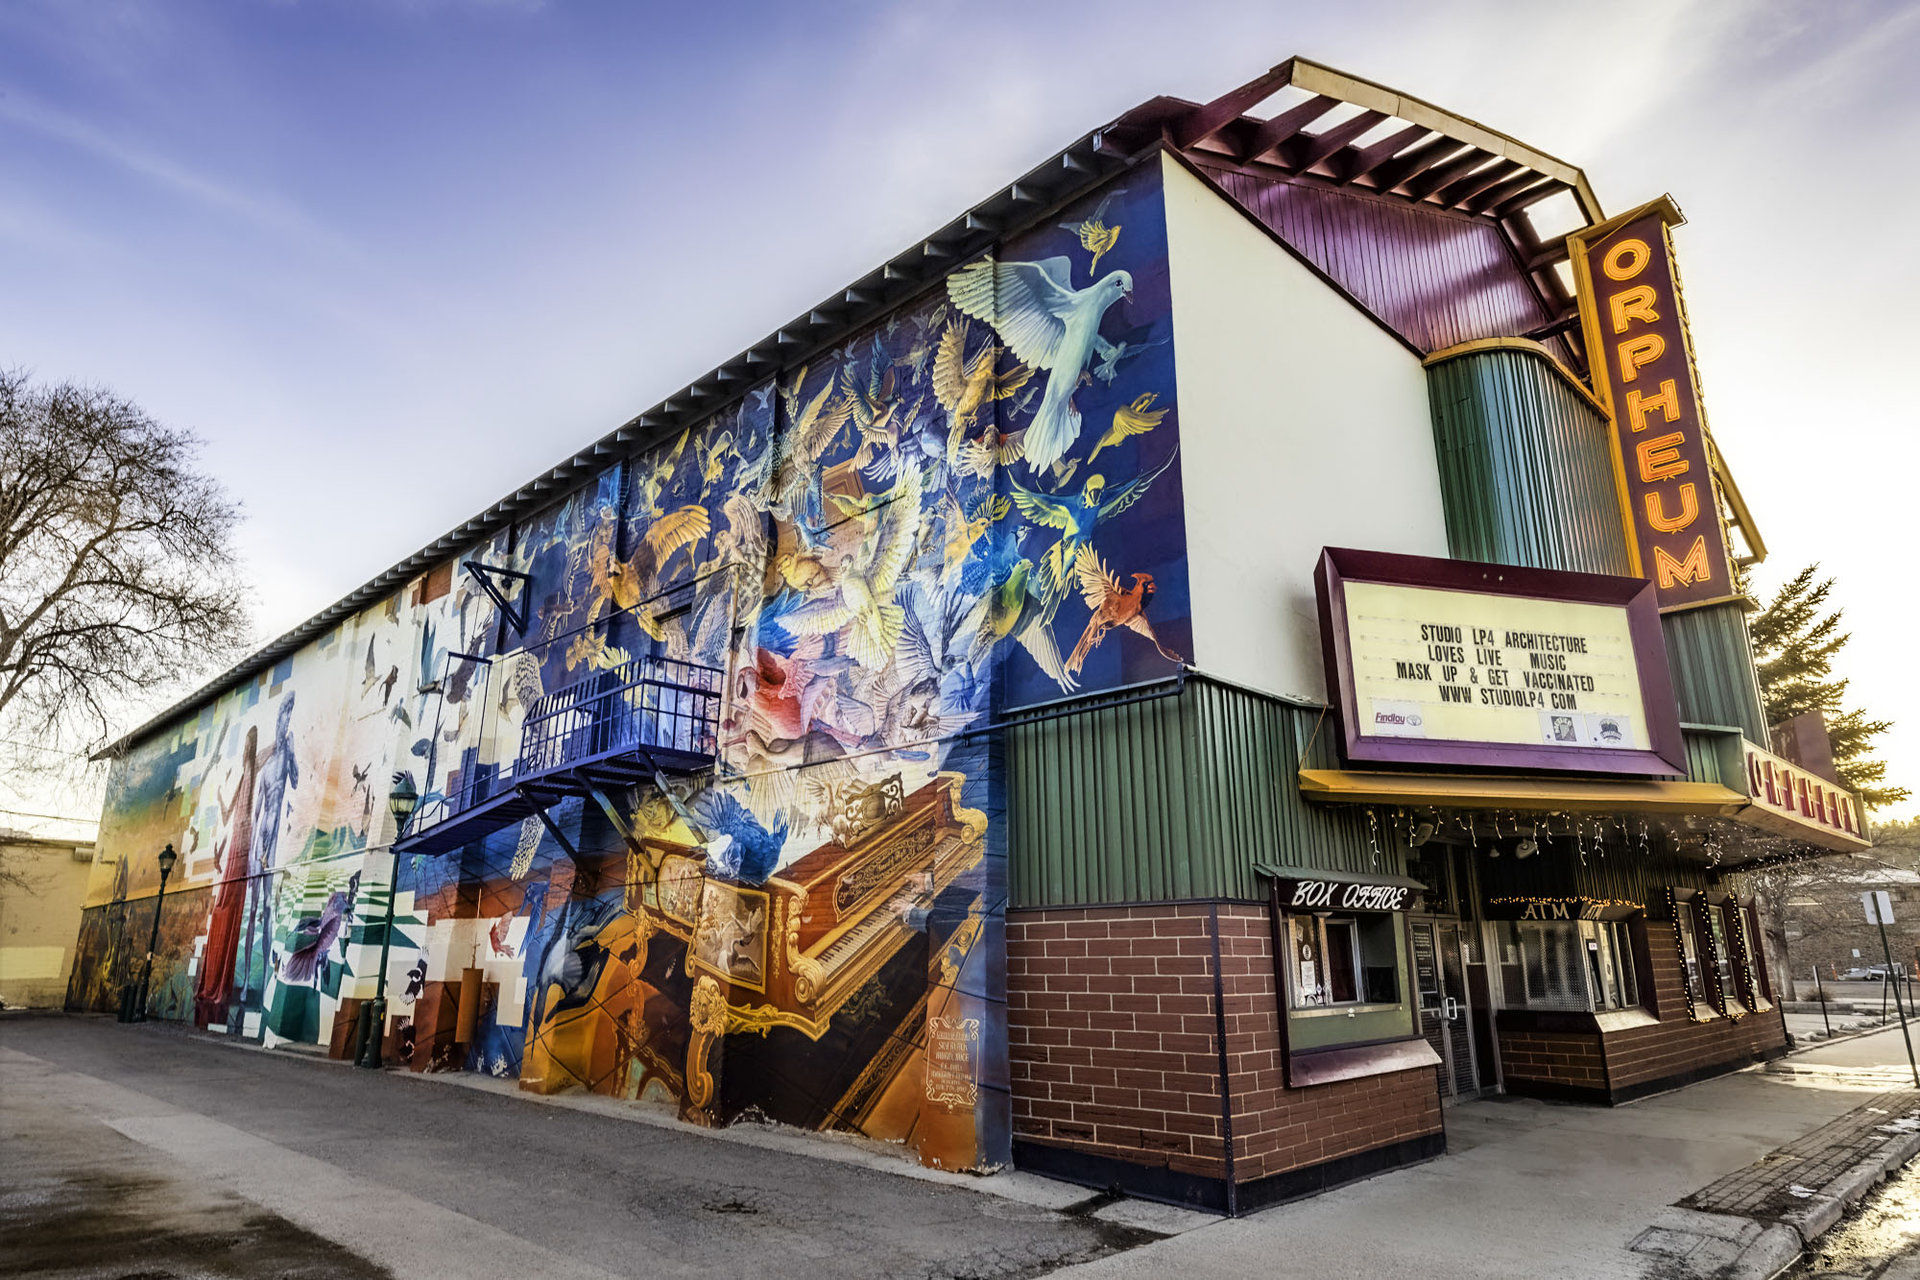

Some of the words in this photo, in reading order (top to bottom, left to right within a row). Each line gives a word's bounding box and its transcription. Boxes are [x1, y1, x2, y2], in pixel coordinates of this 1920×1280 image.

[1603, 238, 1711, 589] ORPHEUM
[1421, 624, 1462, 644] STUDIO
[1472, 628, 1495, 646] LP4
[1505, 631, 1588, 654] ARCHITECTURE
[1427, 644, 1465, 663] LOVES
[1476, 648, 1503, 666] LIVE
[1529, 652, 1566, 671] MUSIC
[1396, 662, 1432, 681] MASK
[1442, 665, 1458, 682] UP
[1470, 667, 1479, 684] &
[1488, 668, 1509, 686] GET
[1523, 671, 1595, 692] VACCINATED
[1439, 685, 1472, 704] WWW
[1480, 688, 1545, 708] STUDIOLP4
[1551, 693, 1577, 710] COM
[1291, 880, 1339, 906] BOX
[1342, 883, 1408, 910] OFFICE
[1520, 902, 1570, 920] ATM
